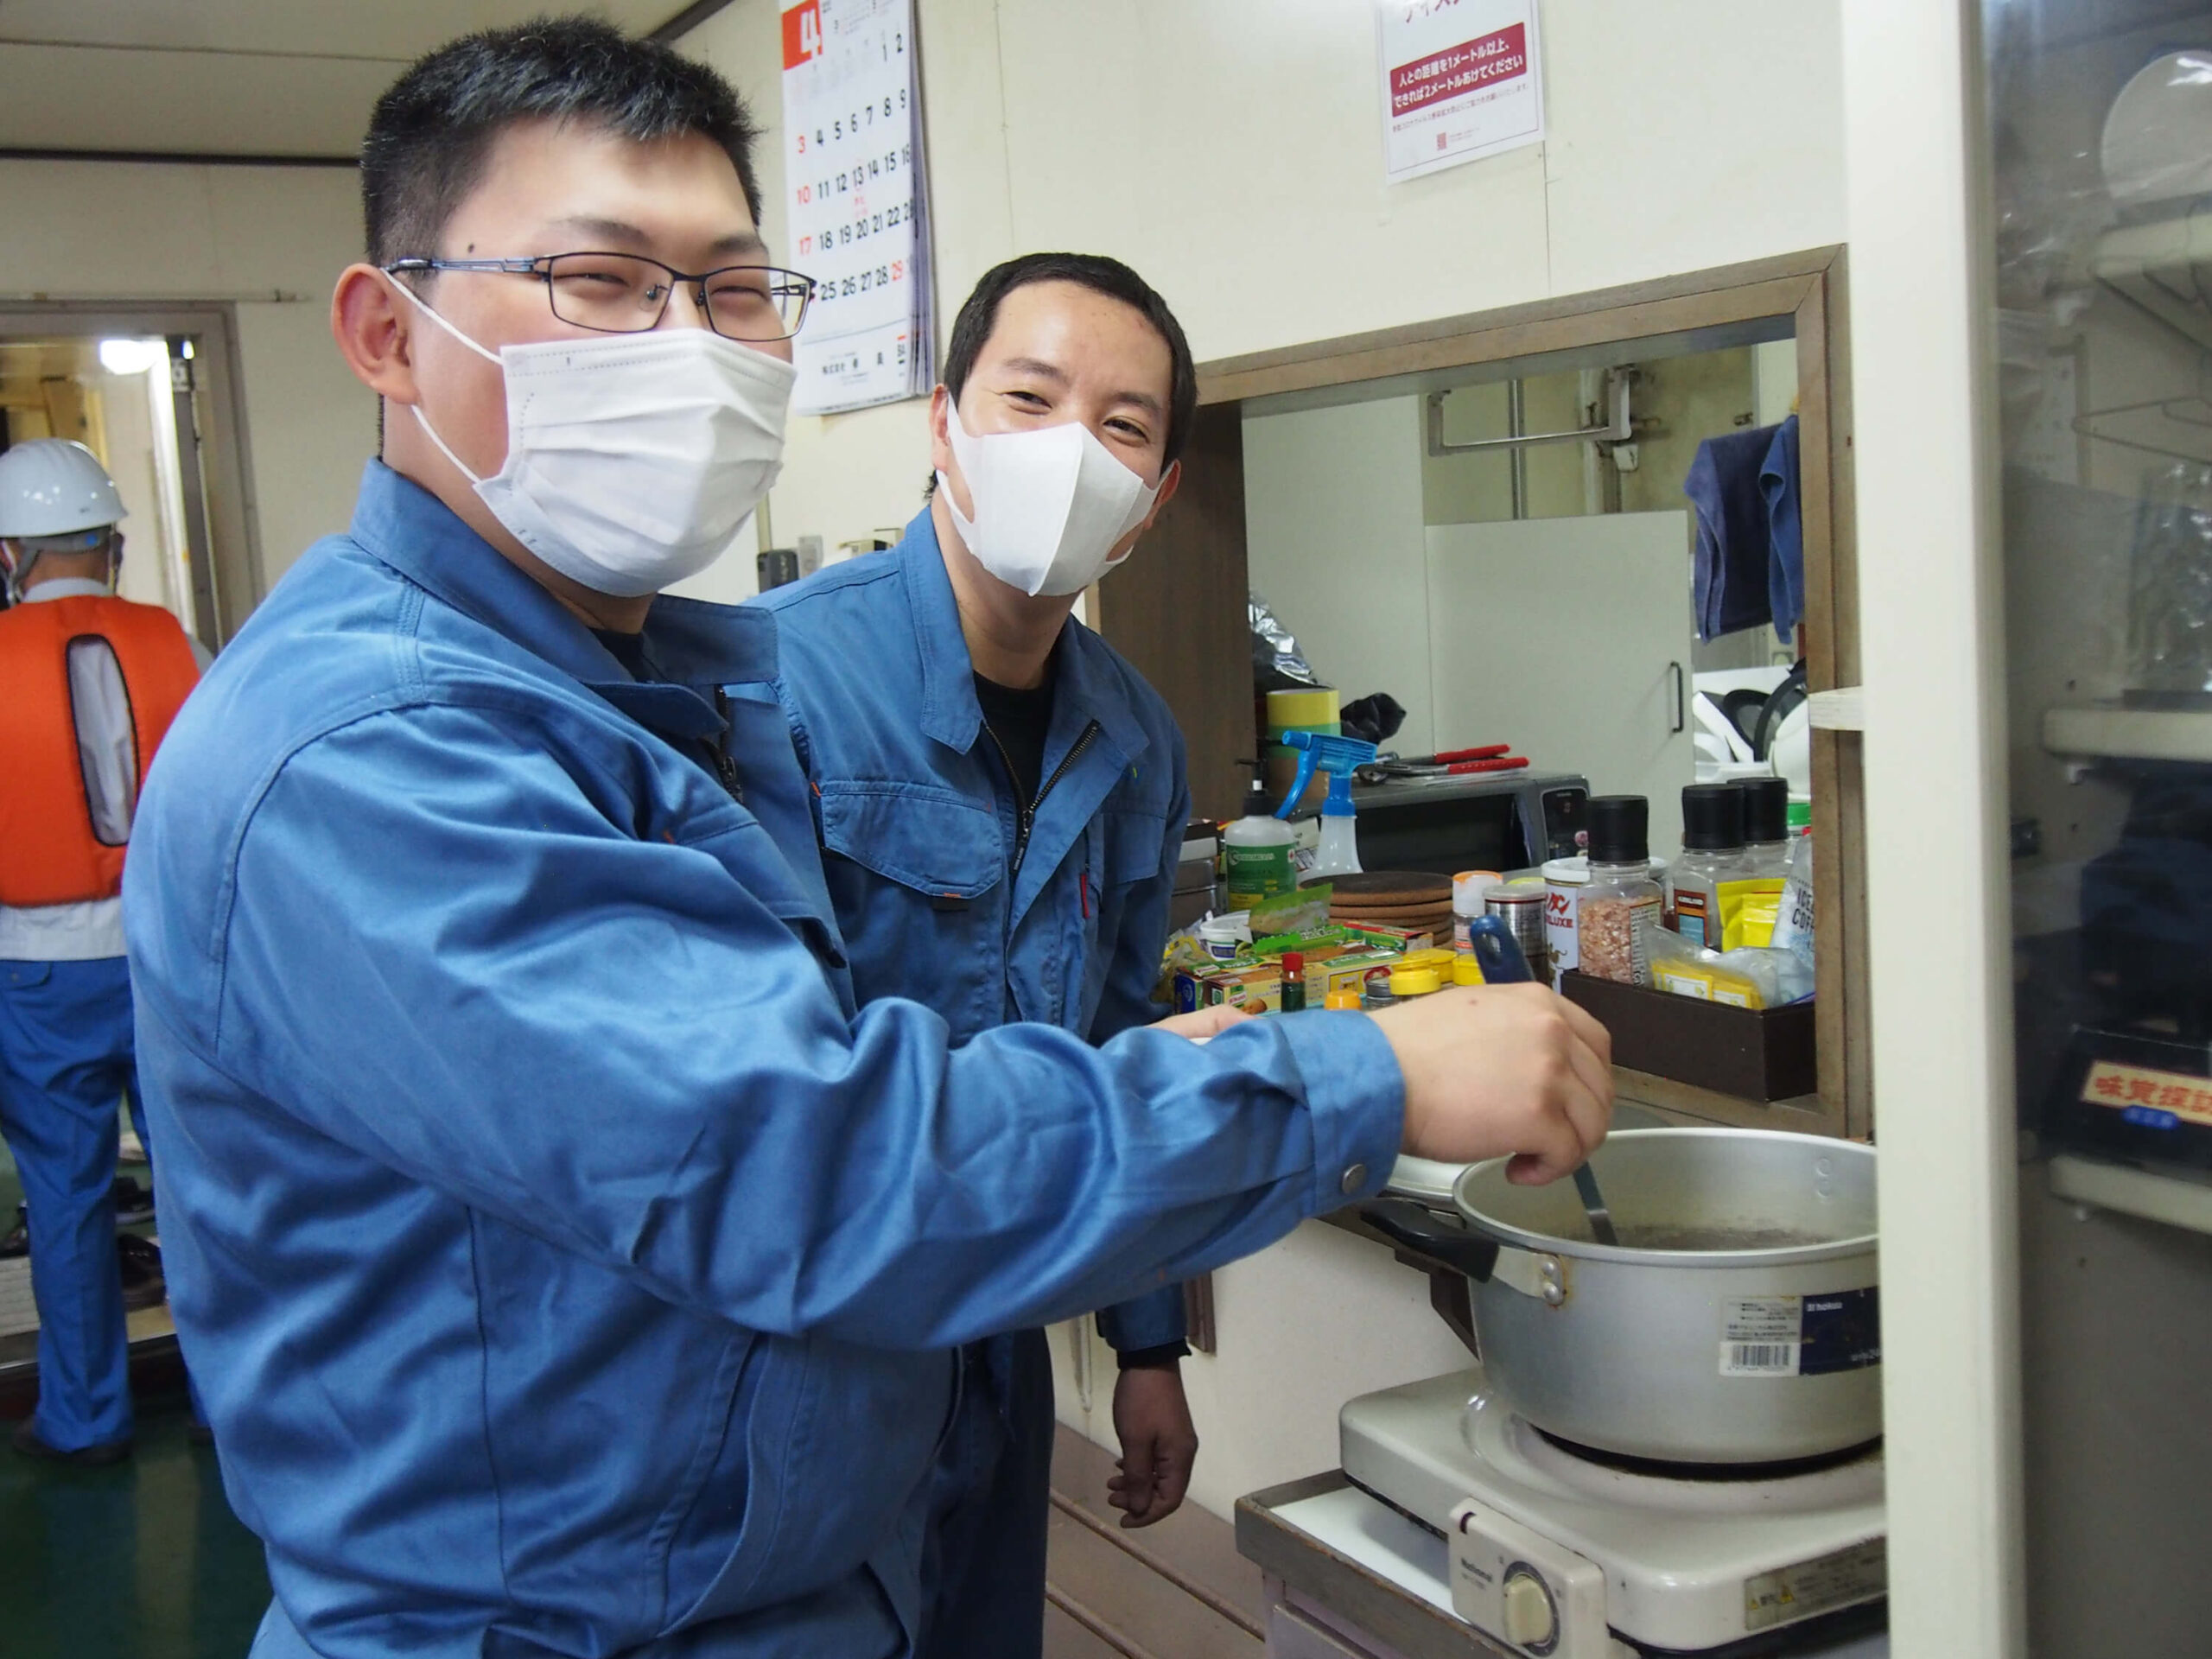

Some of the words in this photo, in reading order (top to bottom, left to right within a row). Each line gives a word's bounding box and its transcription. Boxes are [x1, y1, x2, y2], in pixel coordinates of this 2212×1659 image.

[801, 8, 822, 59] 4
[882, 43, 887, 61] 1
[896, 33, 903, 54] 2
[798, 135, 805, 154] 3
[817, 129, 824, 146] 4
[835, 121, 842, 140] 5
[851, 113, 858, 132] 6
[866, 105, 873, 125] 7
[884, 97, 892, 118] 8
[900, 88, 906, 109] 9
[798, 185, 810, 205] 10
[818, 181, 830, 200] 11
[836, 174, 848, 193] 12
[853, 166, 863, 187] 13
[868, 160, 879, 180] 14
[885, 151, 896, 173] 15
[799, 236, 811, 256] 17
[819, 231, 834, 251] 18
[839, 225, 852, 245] 19
[856, 219, 868, 240] 20
[873, 214, 883, 233] 21
[887, 206, 900, 227] 22
[820, 281, 836, 302] 25
[842, 276, 855, 296] 26
[861, 271, 872, 292] 27
[876, 266, 888, 287] 28
[892, 259, 903, 282] 29
[1545, 914, 1573, 928] ELUXE
